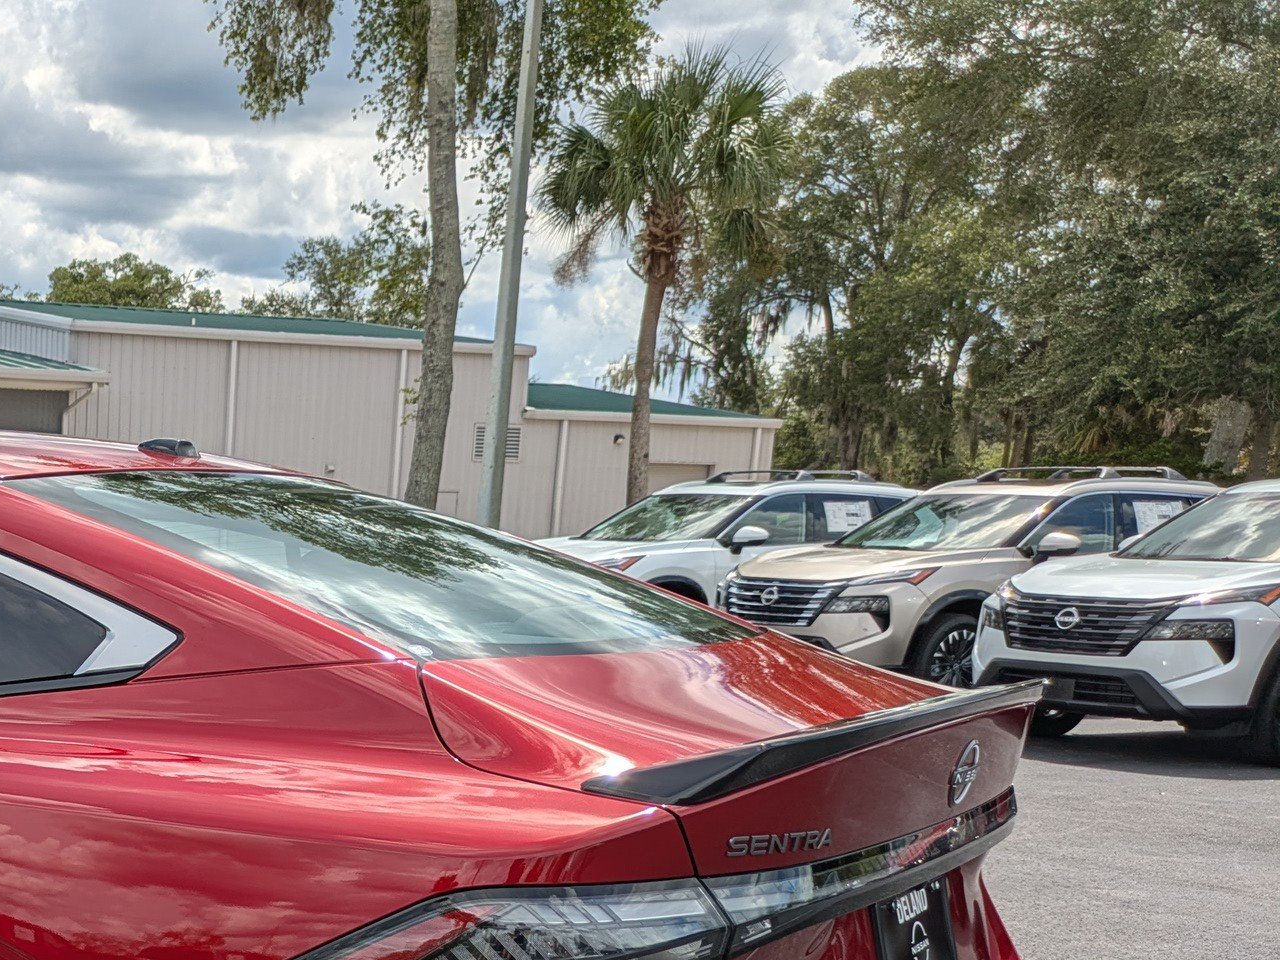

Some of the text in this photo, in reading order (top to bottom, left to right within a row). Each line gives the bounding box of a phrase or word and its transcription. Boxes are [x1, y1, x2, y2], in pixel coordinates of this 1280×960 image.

[726, 828, 834, 858] SENTRA
[897, 888, 928, 924] DELAND
[911, 937, 930, 955] NISSAN
